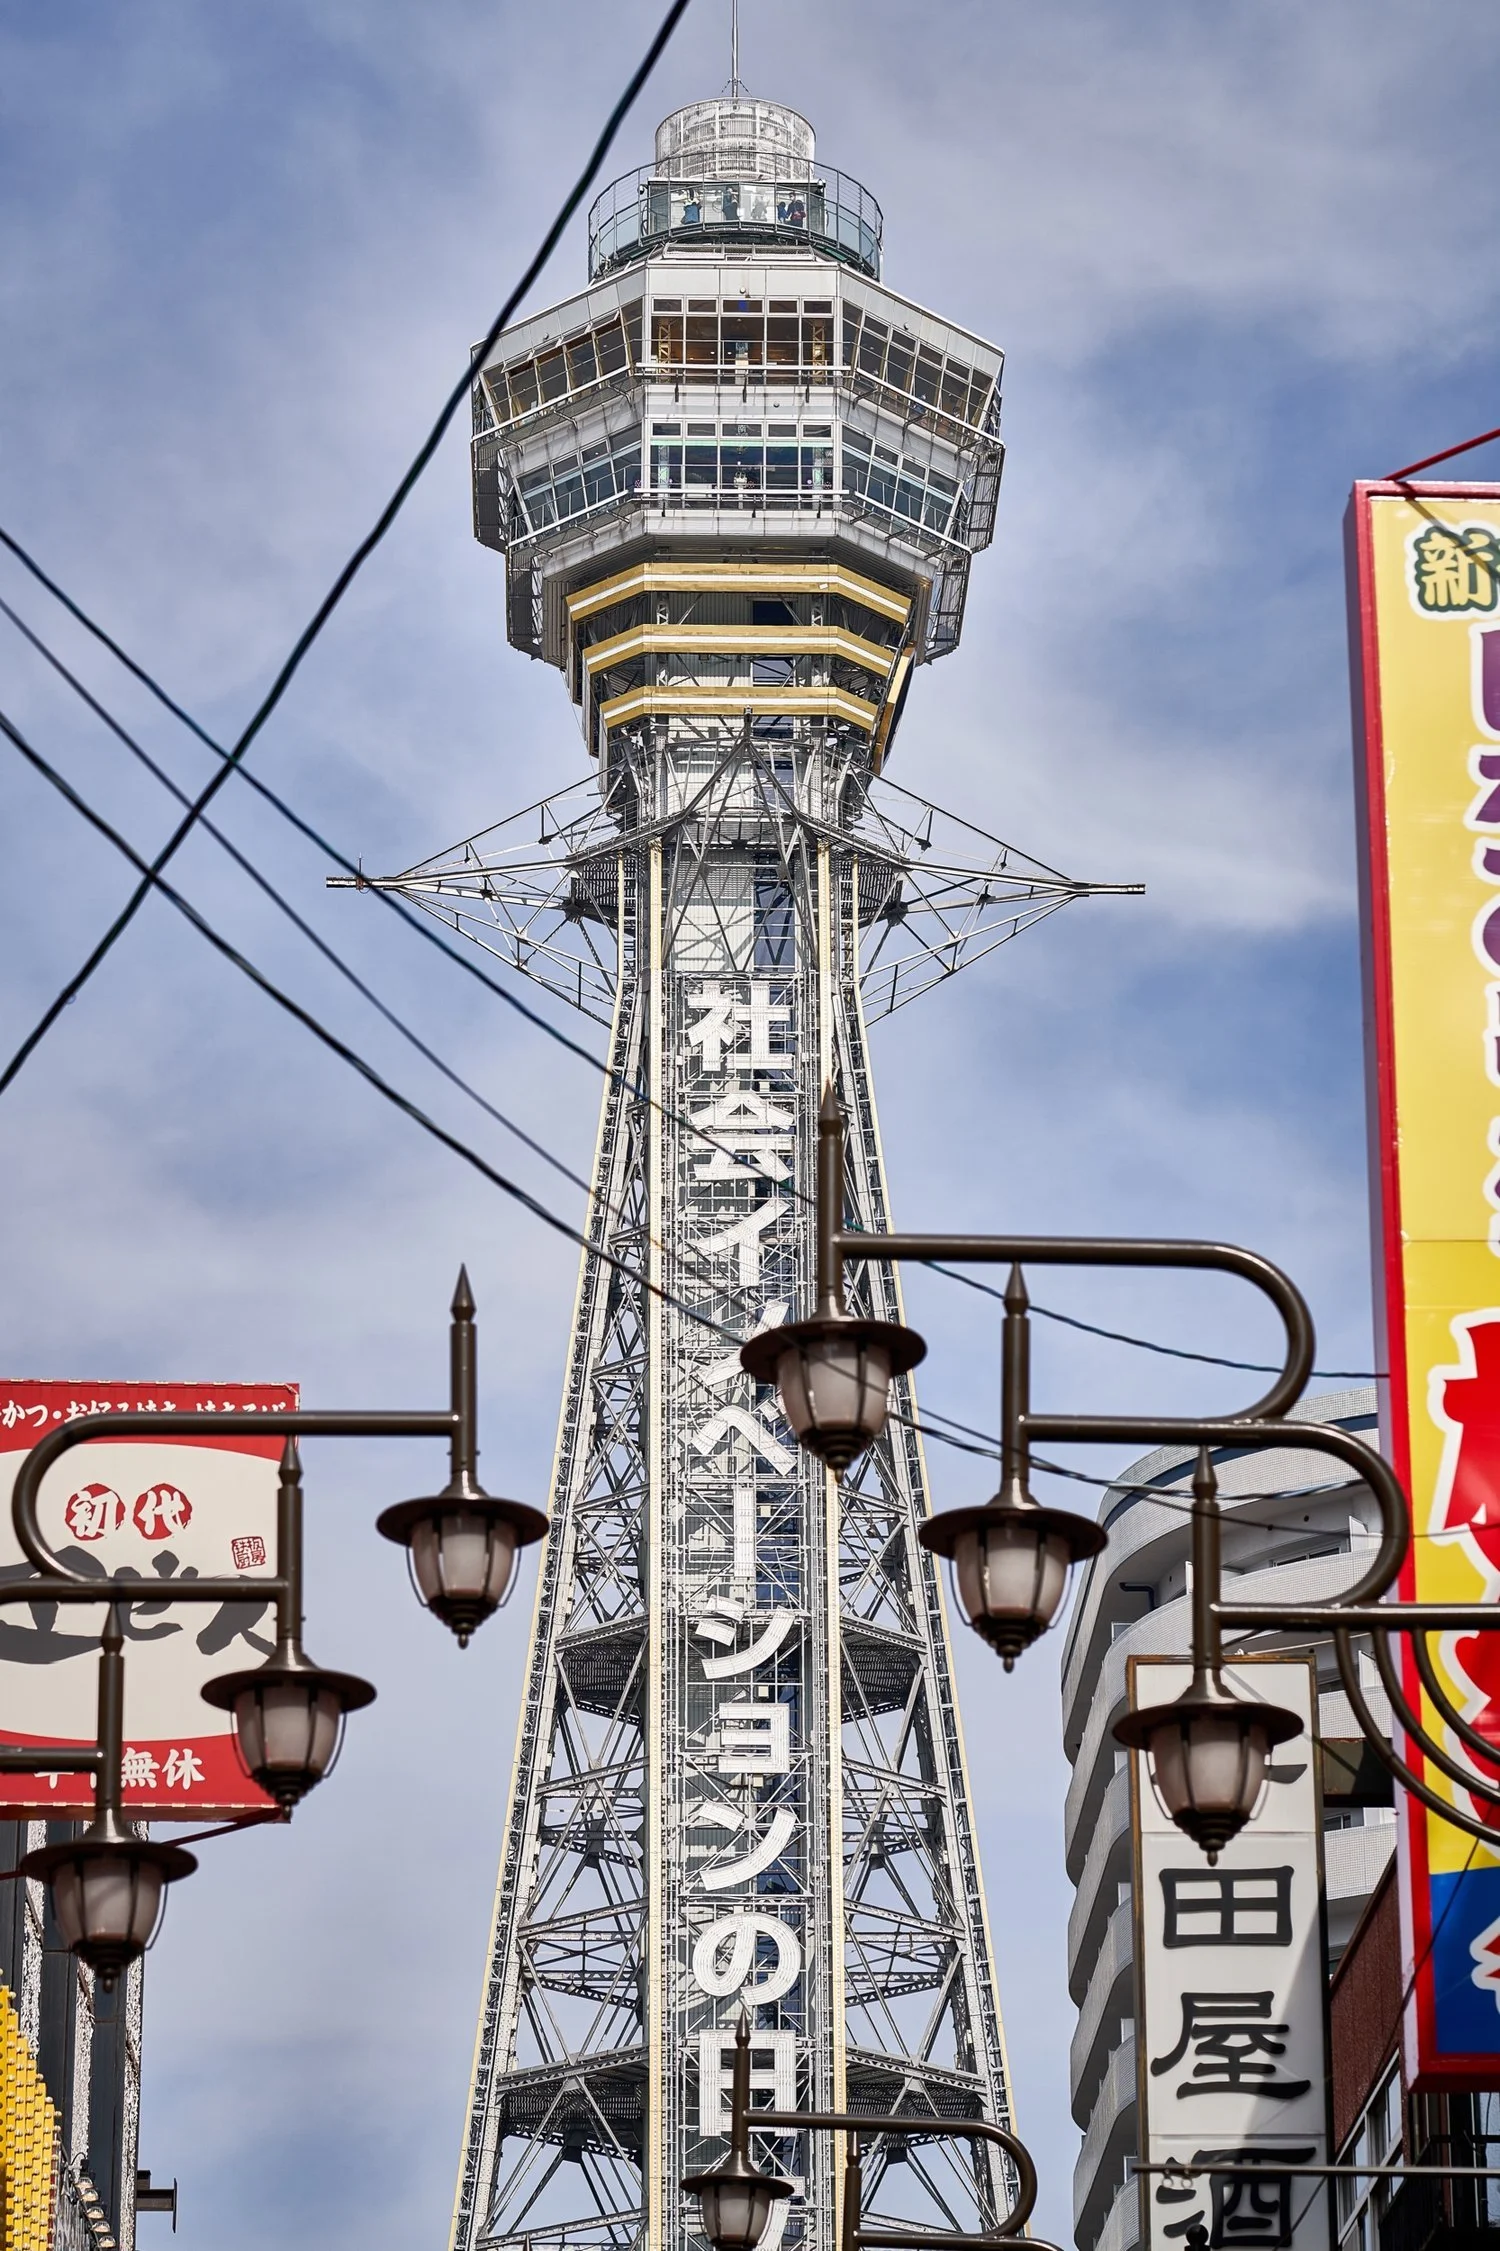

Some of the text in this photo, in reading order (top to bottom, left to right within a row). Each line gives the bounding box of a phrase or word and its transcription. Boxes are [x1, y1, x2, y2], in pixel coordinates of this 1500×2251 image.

[1415, 528, 1500, 612] 新
[66, 1484, 193, 1540] 初代
[1150, 1763, 1318, 2249] 田屋酒
